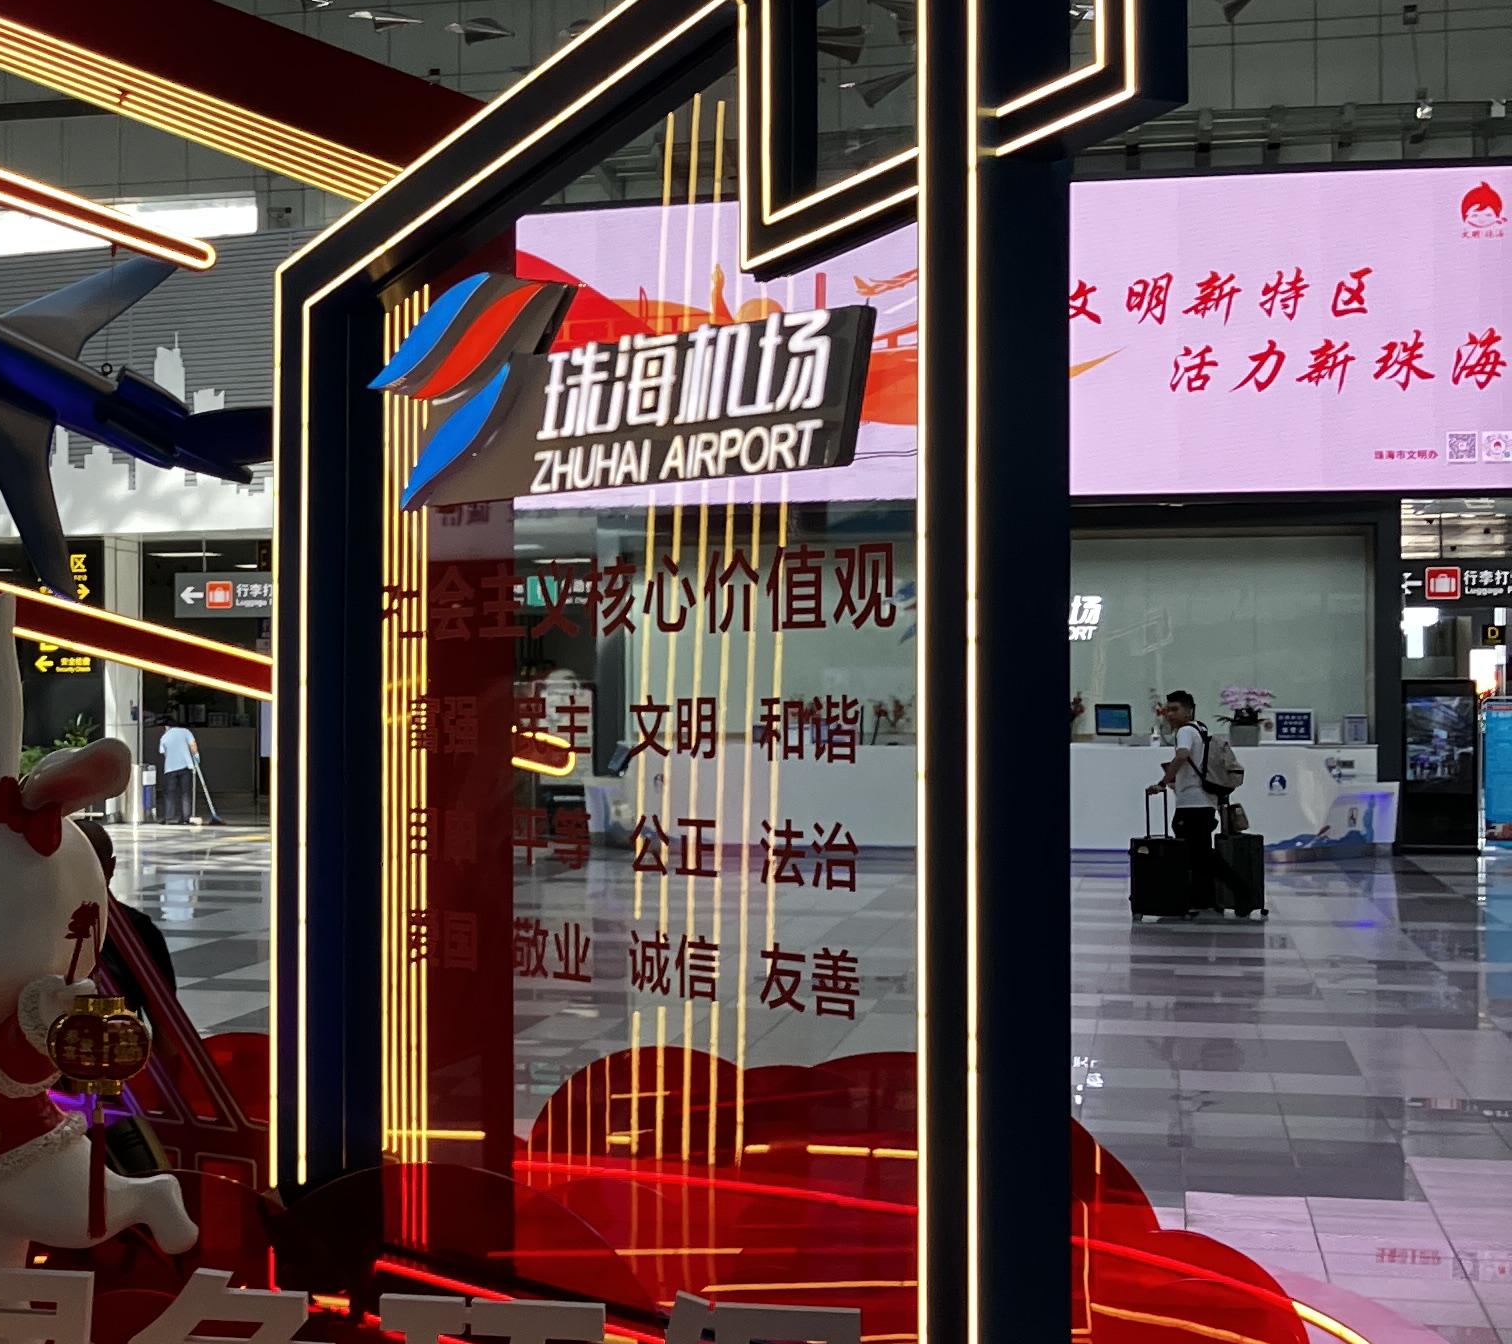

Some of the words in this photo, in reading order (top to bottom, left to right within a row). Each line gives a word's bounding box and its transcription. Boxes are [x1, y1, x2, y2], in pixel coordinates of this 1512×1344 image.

[1068, 266, 1374, 326] 文明新特区
[535, 308, 833, 442] 珠海机场
[1169, 327, 1508, 395] 活力新珠海
[530, 437, 651, 495] ZHUHAI
[658, 418, 825, 481] AIRPORT
[630, 694, 717, 760] 文明
[759, 693, 861, 765] 和谐
[630, 813, 722, 879] 公正
[760, 817, 860, 893] 法治
[512, 916, 592, 984] 敬业
[629, 929, 720, 1002] 诚信
[760, 942, 861, 1021] 友善
